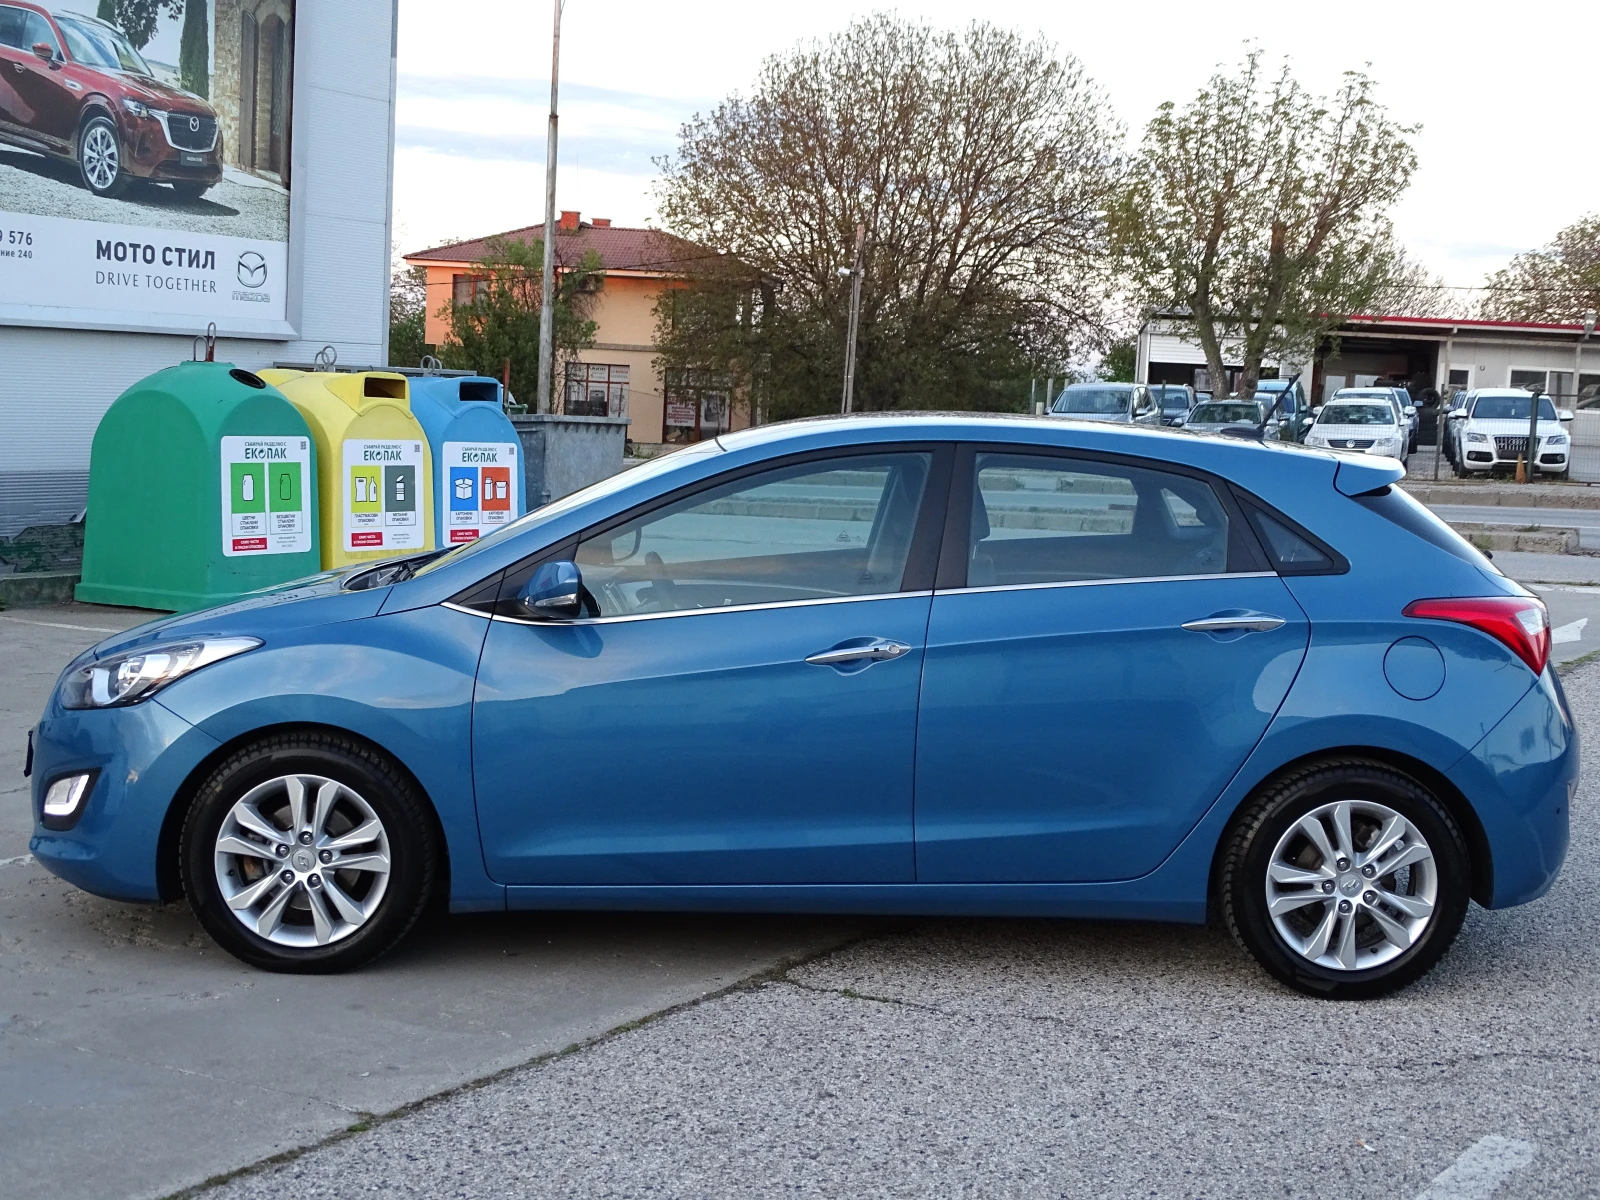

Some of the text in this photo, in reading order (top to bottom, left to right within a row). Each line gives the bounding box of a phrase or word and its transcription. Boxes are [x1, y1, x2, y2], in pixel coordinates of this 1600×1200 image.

[9, 230, 33, 246] 576
[18, 249, 33, 259] 240
[96, 239, 216, 270] МОТО СТИЛ
[95, 270, 217, 293] DRIVE TOGETHER
